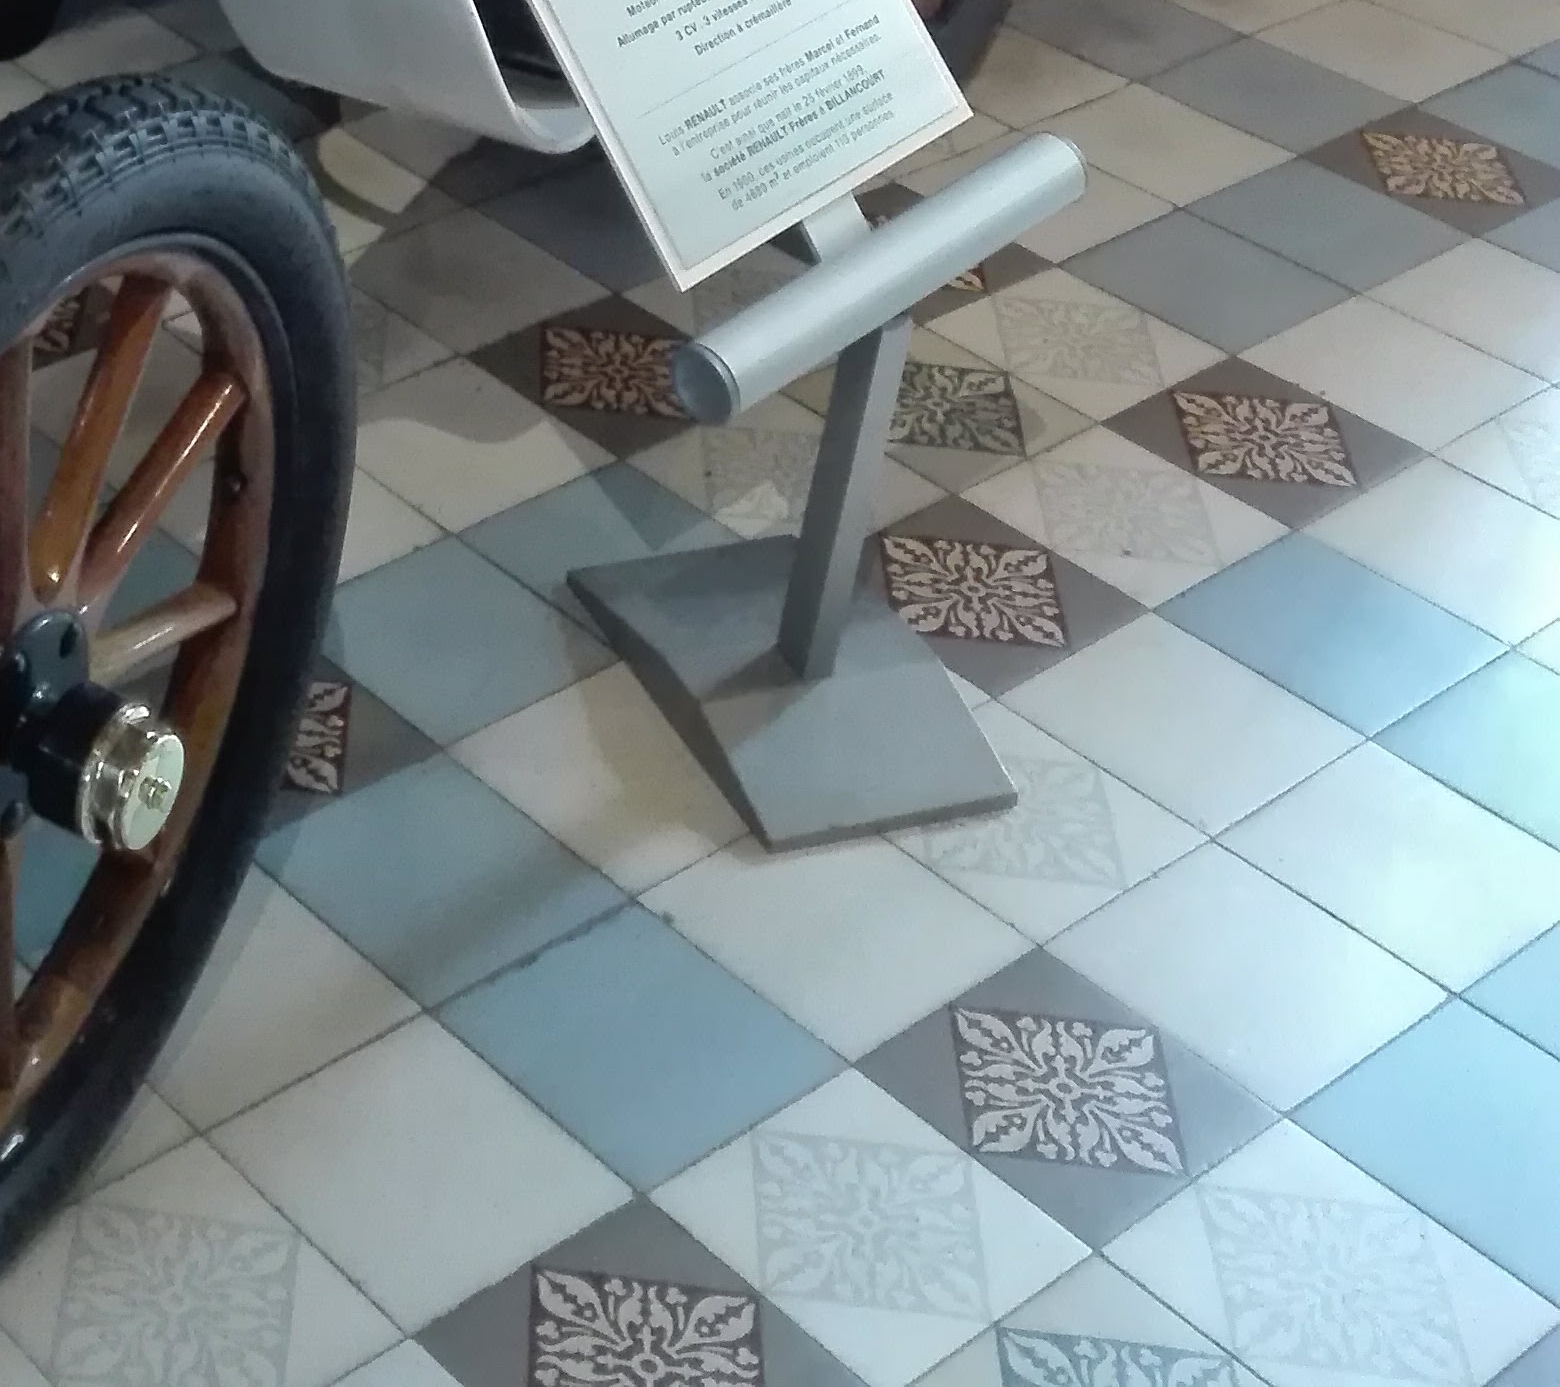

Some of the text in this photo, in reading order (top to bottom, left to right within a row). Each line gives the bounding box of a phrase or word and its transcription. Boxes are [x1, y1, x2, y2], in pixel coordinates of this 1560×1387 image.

[614, 16, 661, 50] Allumage
[659, 10, 678, 26] par
[693, 25, 737, 56] Direction
[656, 122, 686, 146] Louis
[682, 97, 729, 131] RENAULT
[762, 71, 780, 87] ses
[803, 37, 836, 63] Marcel
[843, 12, 881, 40] Fernand
[711, 149, 748, 177] société
[745, 124, 790, 157] RENAULT
[823, 67, 887, 112] BILLANCOURT
[730, 104, 753, 124] pour
[778, 79, 794, 95] les
[756, 117, 777, 135] que
